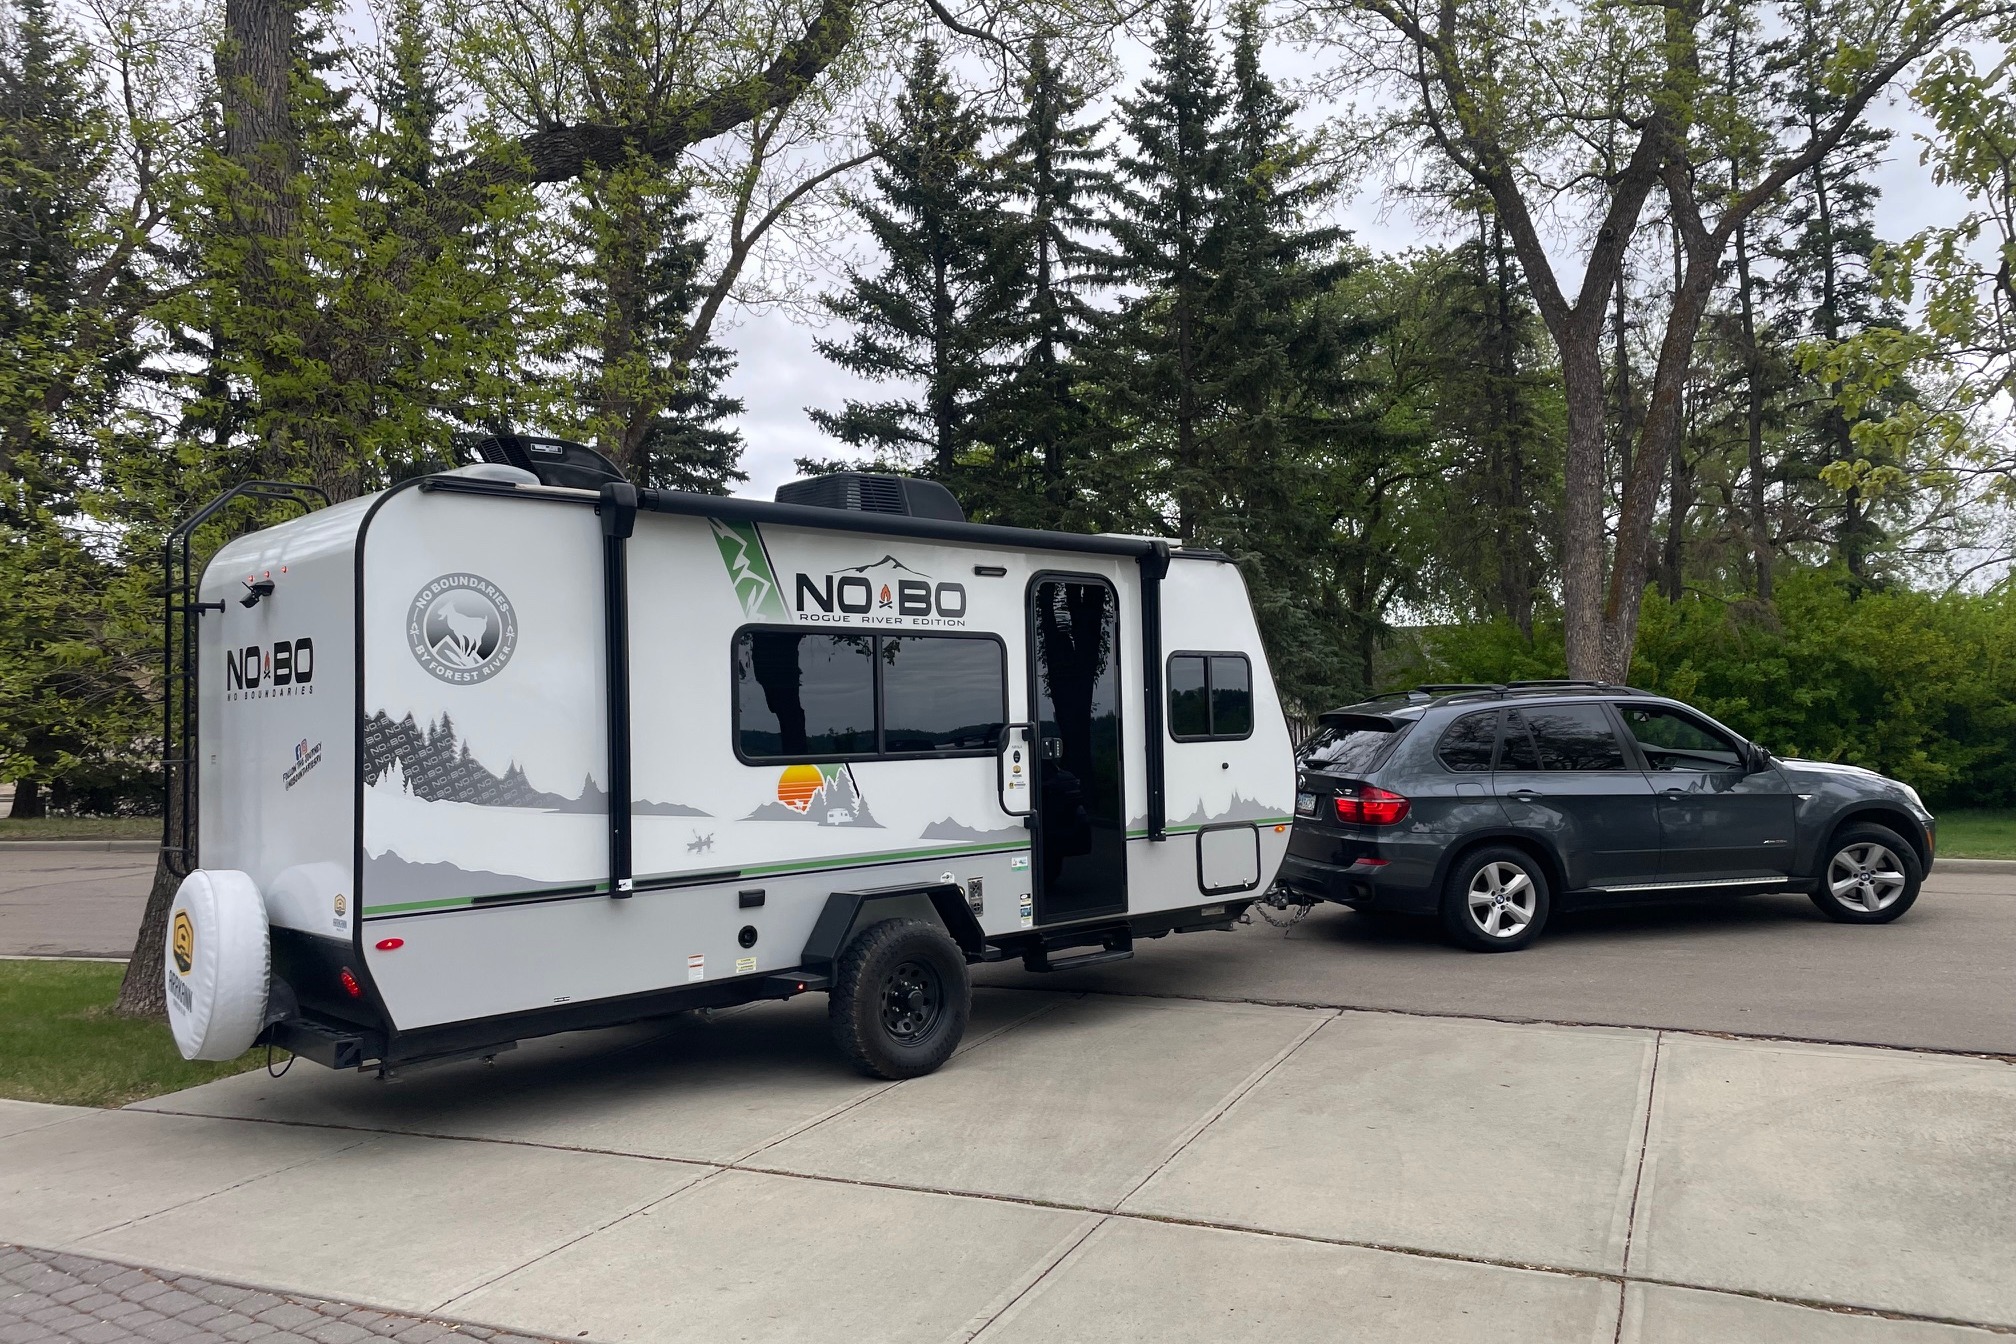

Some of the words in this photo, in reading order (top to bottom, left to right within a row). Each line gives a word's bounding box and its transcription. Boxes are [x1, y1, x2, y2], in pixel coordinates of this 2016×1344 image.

[416, 591, 433, 609] NO
[430, 576, 509, 613] BOUNDARIES
[799, 613, 851, 623] ROGUE
[861, 616, 903, 625] RIVER
[912, 618, 966, 627] EDITION
[415, 645, 431, 661] BY
[429, 662, 479, 682] FOREST
[481, 645, 511, 676] RIVER
[244, 685, 313, 700] BOUNDARIES
